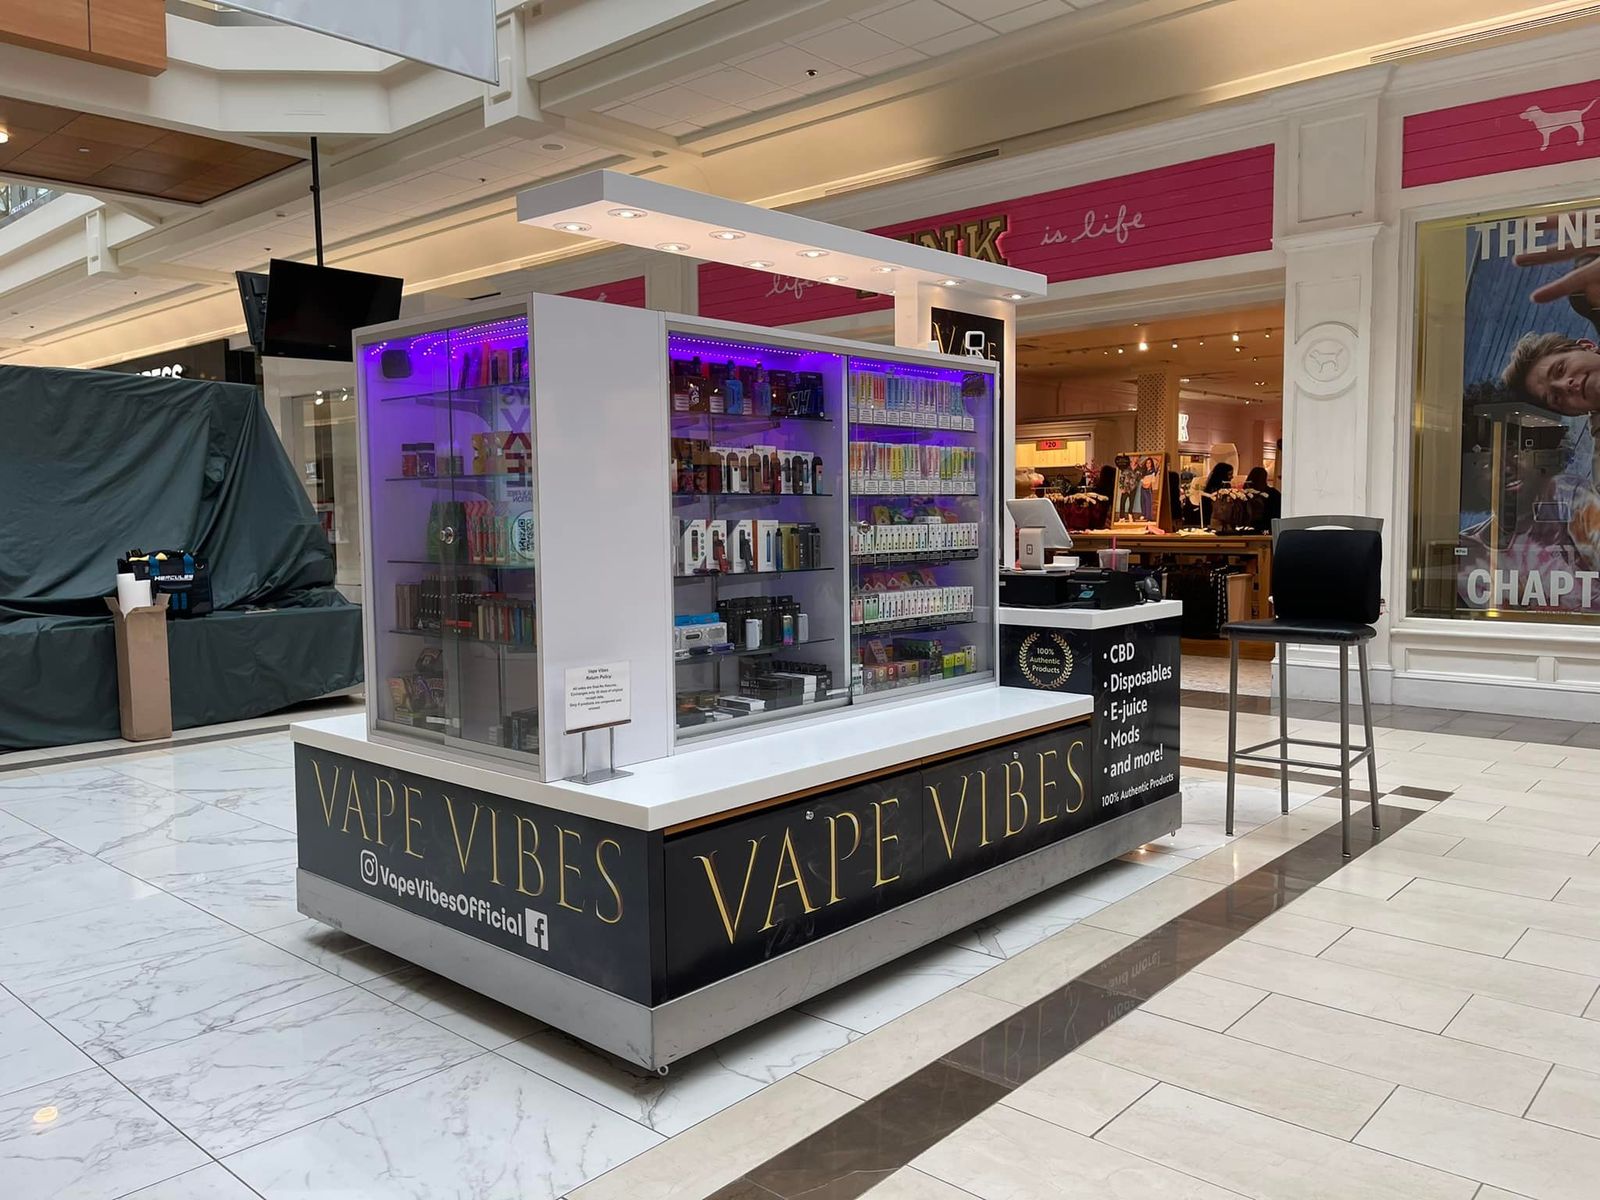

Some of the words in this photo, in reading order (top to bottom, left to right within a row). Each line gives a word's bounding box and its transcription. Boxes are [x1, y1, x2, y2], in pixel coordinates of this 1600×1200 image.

[1040, 226, 1068, 246] is
[1072, 204, 1146, 244] life
[1475, 216, 1548, 260] THE
[1467, 568, 1599, 608] CHAPT
[1030, 656, 1060, 665] Authentic
[1032, 664, 1060, 674] Products
[1110, 642, 1135, 664] CBD
[1110, 664, 1172, 694] Disposables
[1110, 698, 1148, 724] E-juice
[1110, 725, 1140, 750] Mods
[1110, 754, 1131, 778] and
[1134, 744, 1163, 770] more!
[1102, 792, 1120, 807] 100%
[1120, 781, 1149, 800] Authentic
[1150, 773, 1174, 789] Products
[311, 760, 425, 860] VAPE
[442, 794, 624, 924] VIBES
[693, 798, 901, 945] VAPE
[924, 740, 1084, 860] VIBES
[380, 865, 523, 937] VapeVibesOfficial
